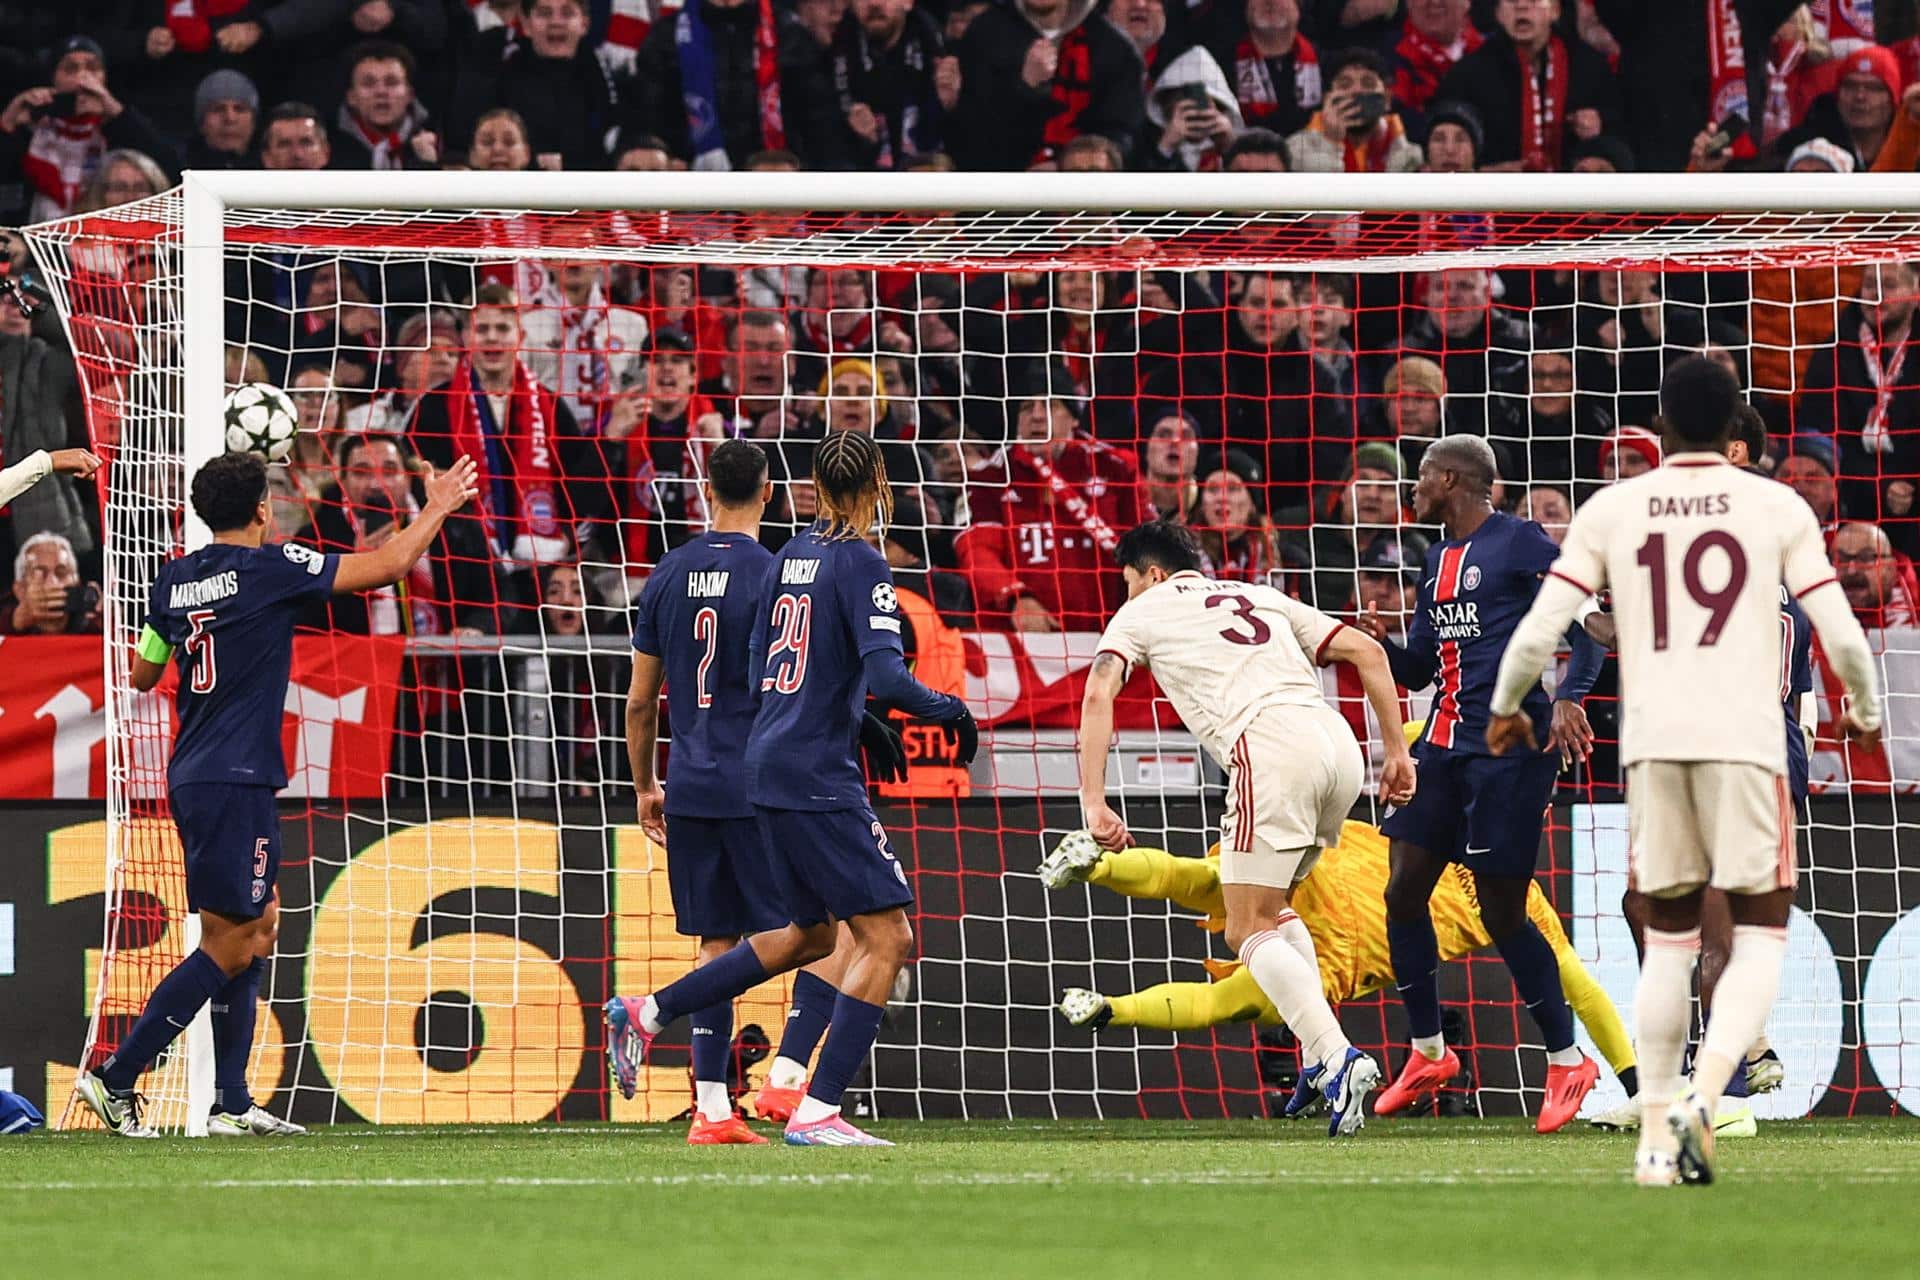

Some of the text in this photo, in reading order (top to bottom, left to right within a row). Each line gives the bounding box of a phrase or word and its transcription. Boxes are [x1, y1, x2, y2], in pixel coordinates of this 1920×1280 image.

[1649, 493, 1731, 518] DAVIES
[1204, 594, 1271, 646] 3
[1636, 529, 1748, 651] 19
[185, 609, 217, 694] 5
[694, 606, 718, 709] 2
[760, 592, 812, 695] 29
[1438, 624, 1482, 640] AIRWAYS
[253, 837, 271, 878] 5
